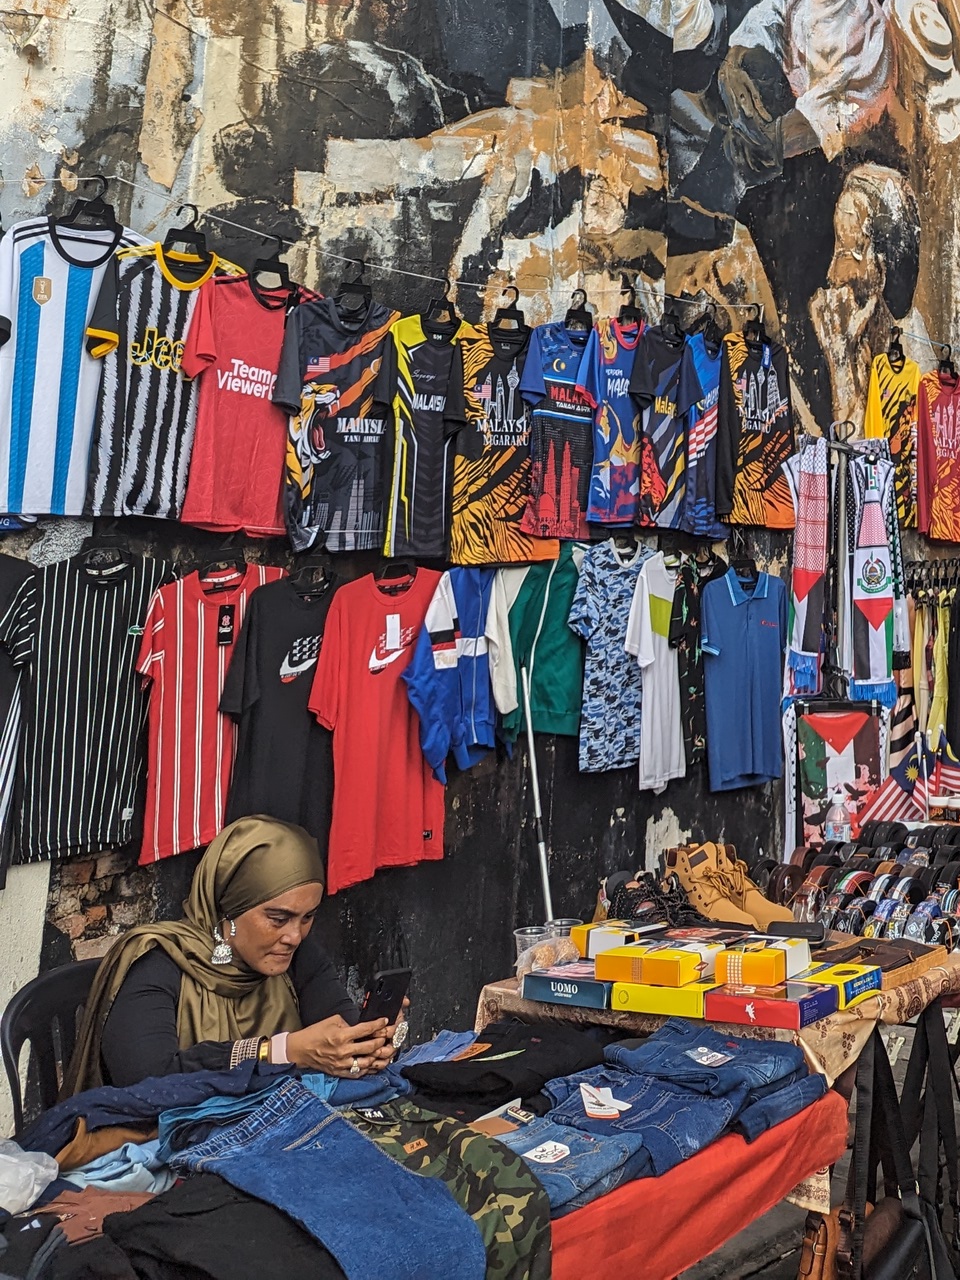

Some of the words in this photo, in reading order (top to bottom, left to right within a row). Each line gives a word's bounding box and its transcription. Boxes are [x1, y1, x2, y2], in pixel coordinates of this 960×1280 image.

[131, 327, 193, 380] Jee
[216, 369, 270, 399] Viewer
[230, 358, 272, 385] Team
[476, 419, 528, 433] MALAYSI
[550, 981, 578, 994] UOMO
